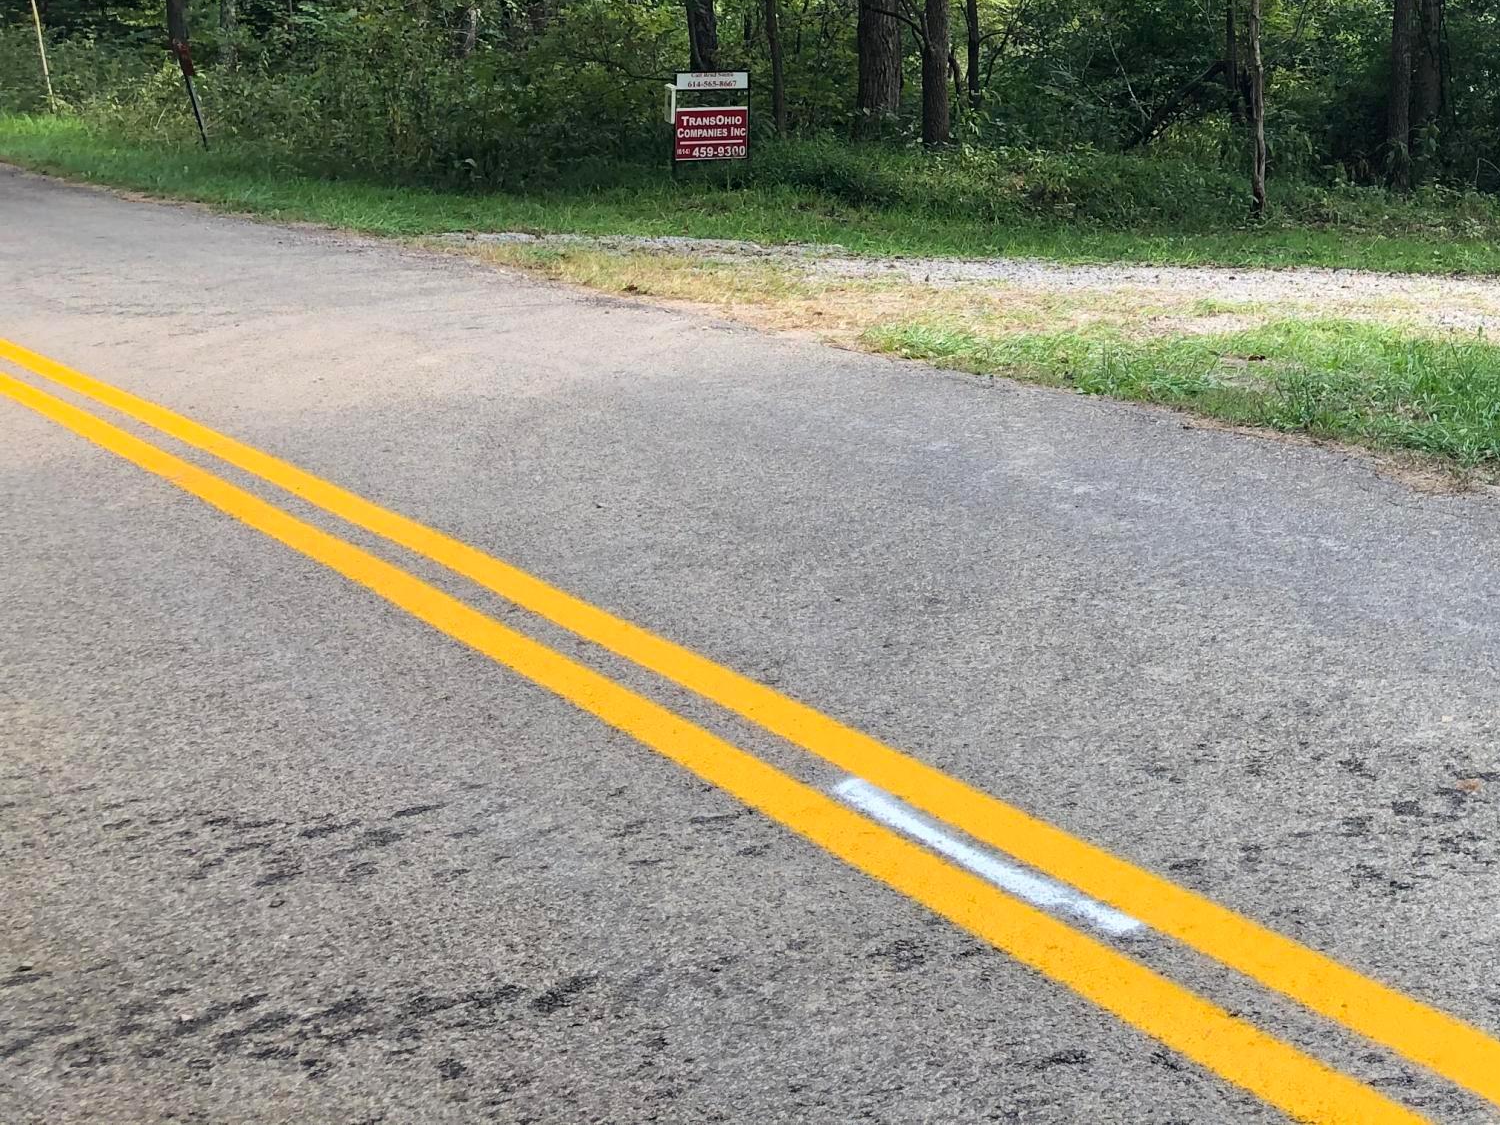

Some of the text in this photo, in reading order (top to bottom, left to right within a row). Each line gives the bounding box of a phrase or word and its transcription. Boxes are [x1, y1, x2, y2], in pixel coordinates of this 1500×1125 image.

[681, 116, 742, 126] TRANSOHIO
[677, 127, 746, 138] COMPANIES INC
[692, 146, 745, 158] 459-9300
